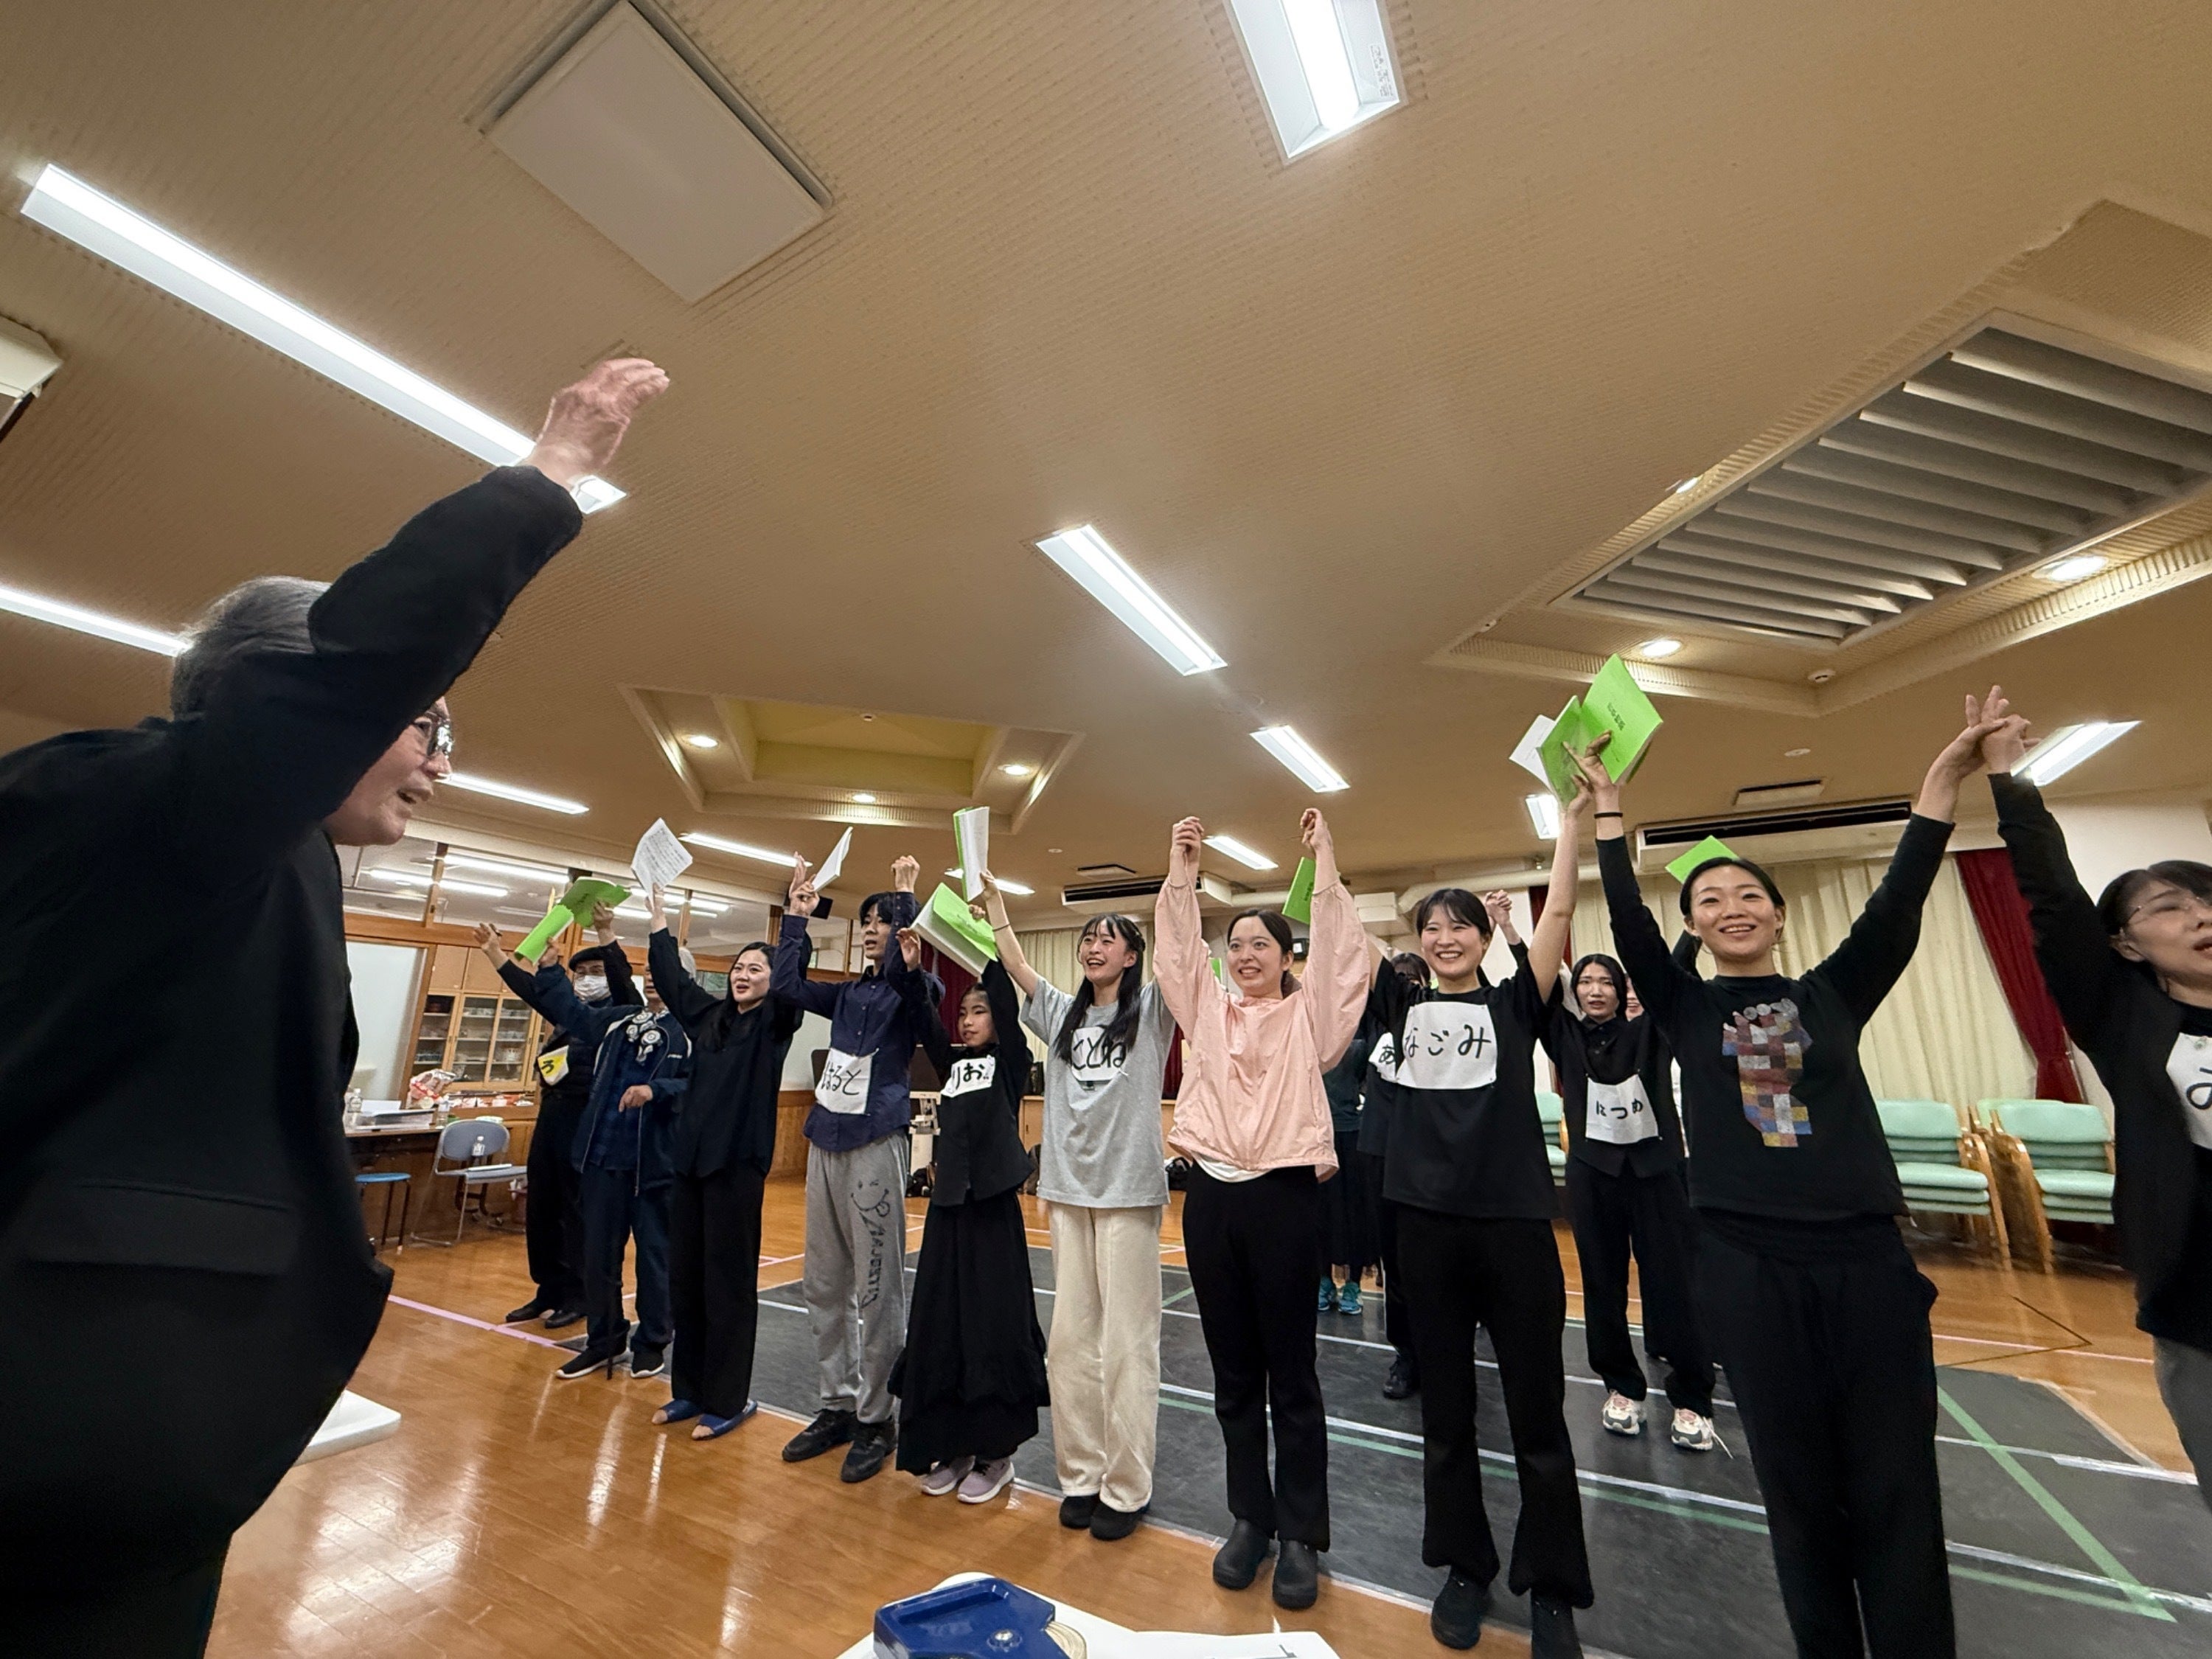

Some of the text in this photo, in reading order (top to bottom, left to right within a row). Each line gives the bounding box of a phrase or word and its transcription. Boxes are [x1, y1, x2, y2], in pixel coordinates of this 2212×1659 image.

[1072, 1028, 1127, 1071] ことね
[1404, 1024, 1492, 1060] なごみ
[821, 1060, 862, 1096] はると
